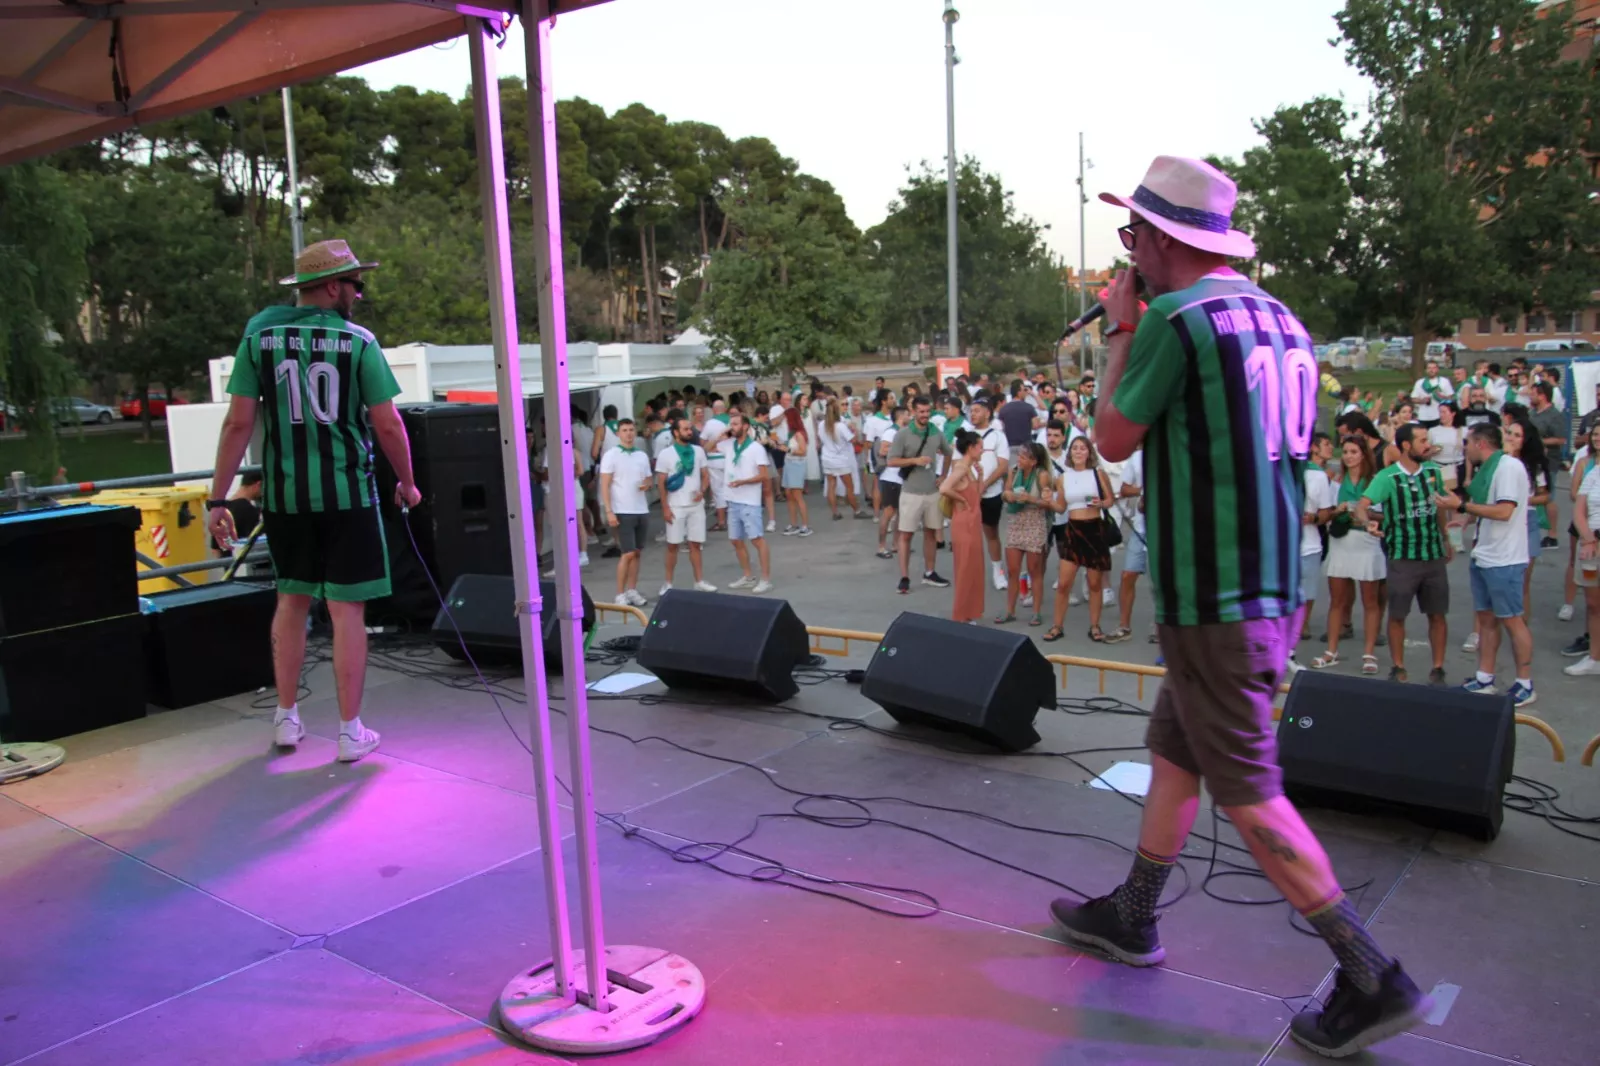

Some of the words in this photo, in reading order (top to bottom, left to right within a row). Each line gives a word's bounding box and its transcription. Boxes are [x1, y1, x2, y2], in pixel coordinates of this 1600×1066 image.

[260, 335, 284, 351] HIJOS
[288, 336, 306, 351] DEL
[312, 337, 352, 353] LINDANO
[275, 359, 340, 424] 10
[1244, 345, 1318, 461] 10
